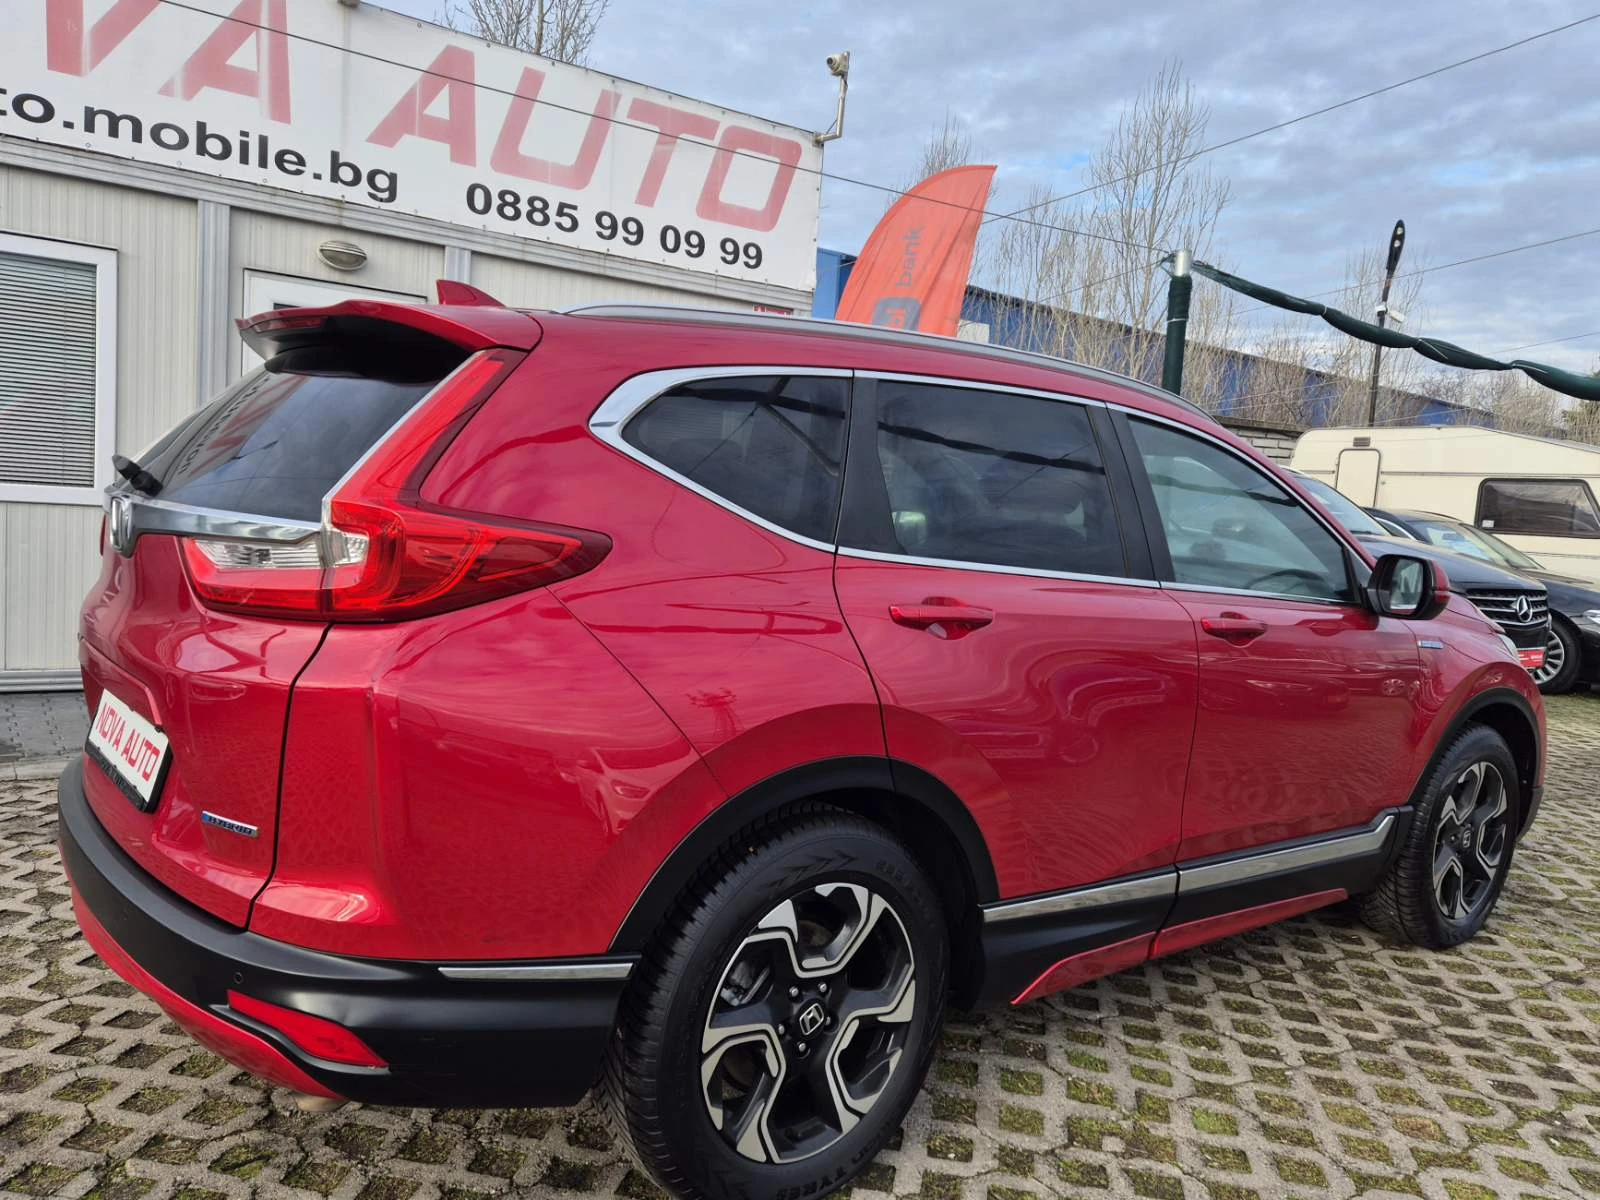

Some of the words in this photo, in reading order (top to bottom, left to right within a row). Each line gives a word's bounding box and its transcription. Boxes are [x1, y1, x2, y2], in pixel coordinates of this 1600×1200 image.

[365, 44, 803, 233] AUTO
[466, 183, 580, 233] 0885
[595, 210, 645, 246] 99
[660, 224, 706, 258] 09
[719, 237, 764, 270] 99
[895, 226, 924, 288] bank
[95, 703, 127, 749] NOVA
[122, 729, 161, 782] AUTO
